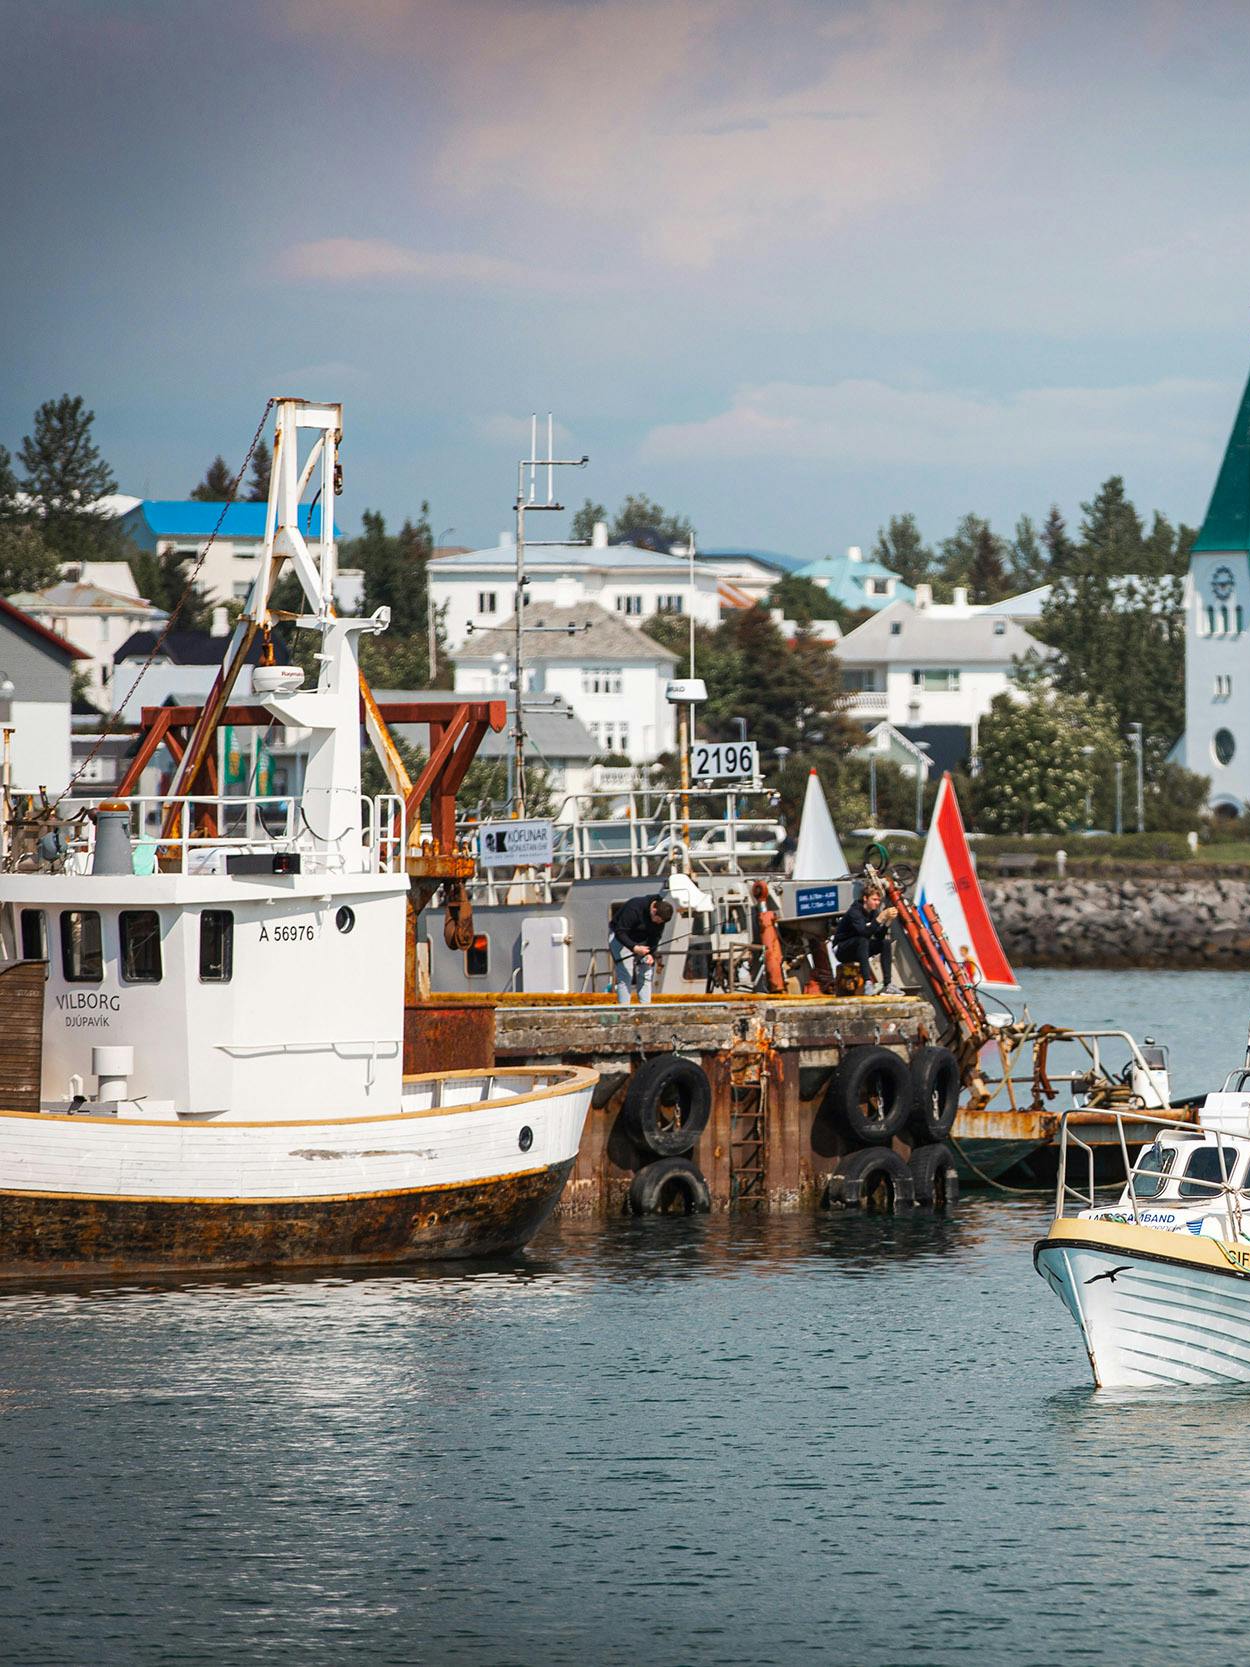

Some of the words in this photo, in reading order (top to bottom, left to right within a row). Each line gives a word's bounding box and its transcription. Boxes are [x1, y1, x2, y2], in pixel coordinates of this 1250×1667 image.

[697, 745, 753, 775] 2196
[259, 926, 270, 942] A
[274, 925, 314, 942] 56976
[55, 992, 120, 1012] VILBORG
[65, 1014, 110, 1028] DJÚPAVÍK
